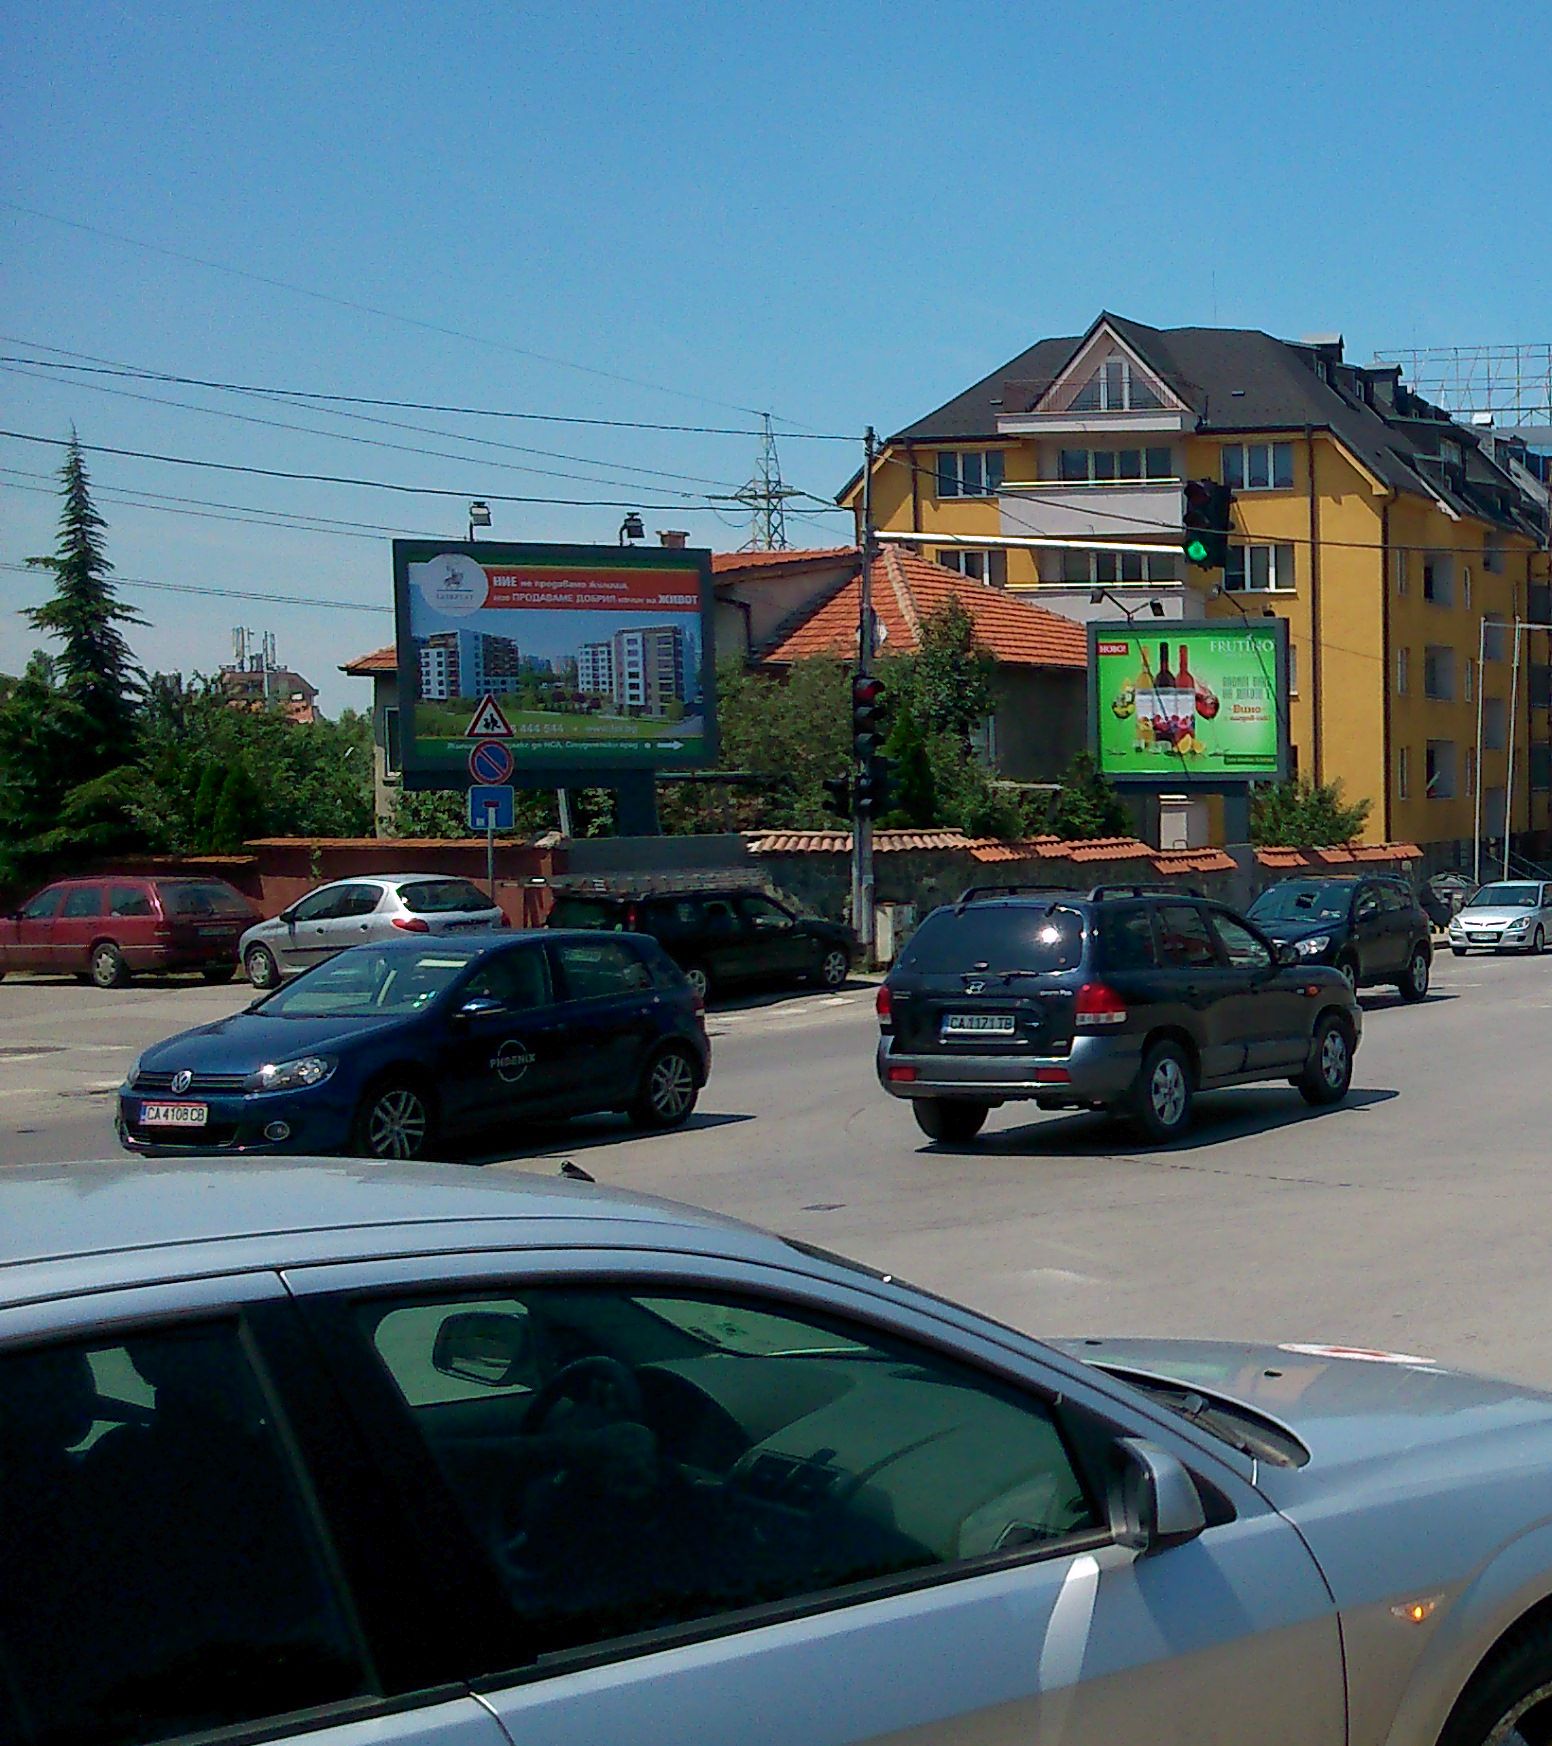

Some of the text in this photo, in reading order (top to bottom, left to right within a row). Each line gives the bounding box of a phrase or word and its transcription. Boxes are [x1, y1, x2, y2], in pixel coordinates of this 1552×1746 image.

[512, 593, 574, 603] ПРОДАВАМЕ
[658, 594, 699, 605] ЖИВОТ
[1210, 639, 1275, 653] FRUTINO
[489, 1053, 536, 1069] PHOENIX
